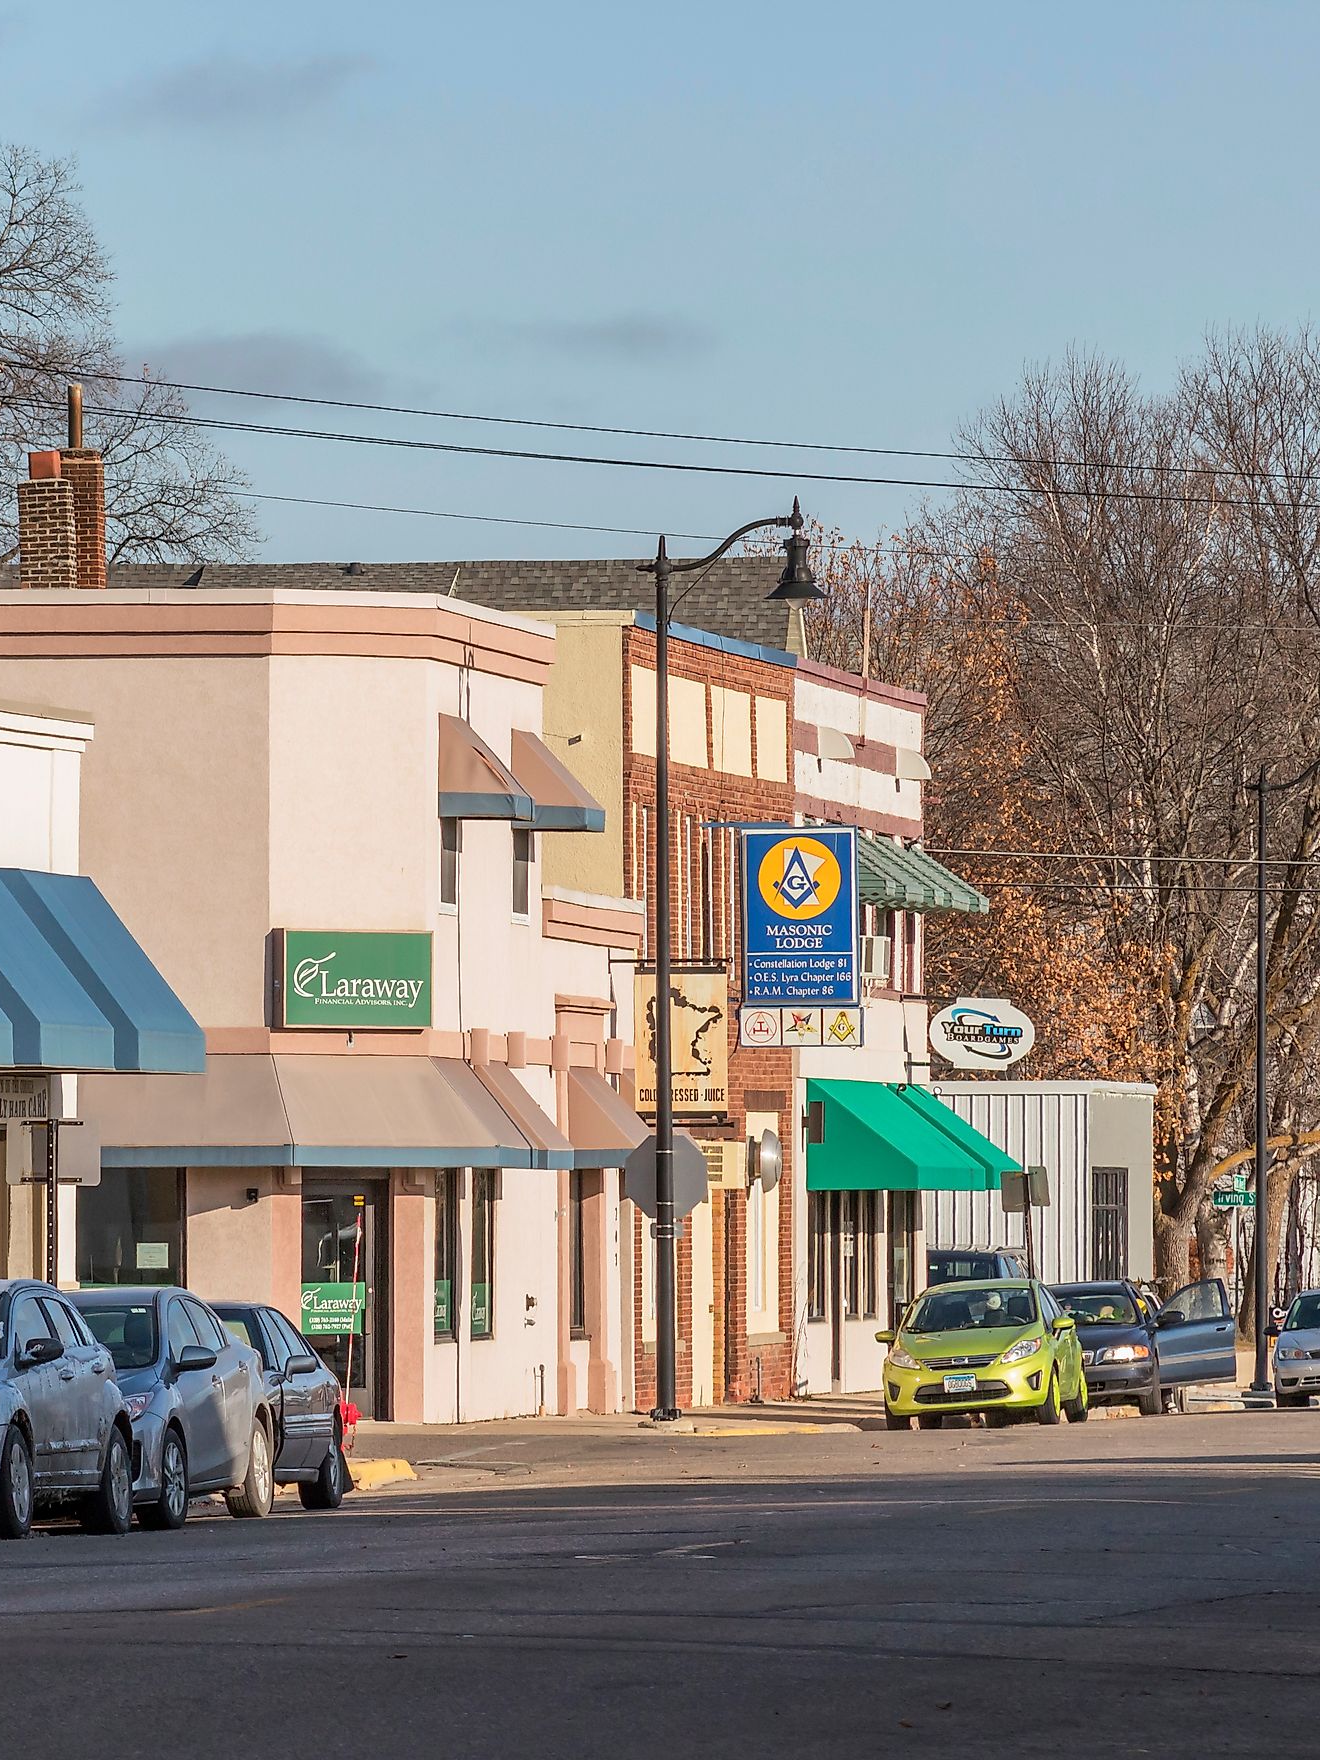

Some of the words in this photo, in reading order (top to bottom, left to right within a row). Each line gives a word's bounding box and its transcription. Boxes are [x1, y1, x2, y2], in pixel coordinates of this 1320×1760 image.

[766, 925, 833, 936] MASONIC
[776, 937, 824, 949] LODGE
[753, 958, 807, 969] Constellation
[810, 958, 835, 971] Lodge
[837, 958, 847, 968] 81
[753, 972, 779, 982] O.E.S.
[781, 972, 799, 984] Lyra
[801, 972, 835, 984] Chapter
[836, 972, 852, 981] 166
[320, 970, 424, 1008] Laraway
[754, 986, 784, 996] R.A.M.
[786, 986, 820, 998] Chapter
[821, 986, 834, 996] 86
[942, 1022, 983, 1035] Your
[983, 1024, 1022, 1037] Turn
[703, 1088, 725, 1102] JUICE
[1218, 1192, 1245, 1206] Irving
[313, 1296, 362, 1313] Laraway
